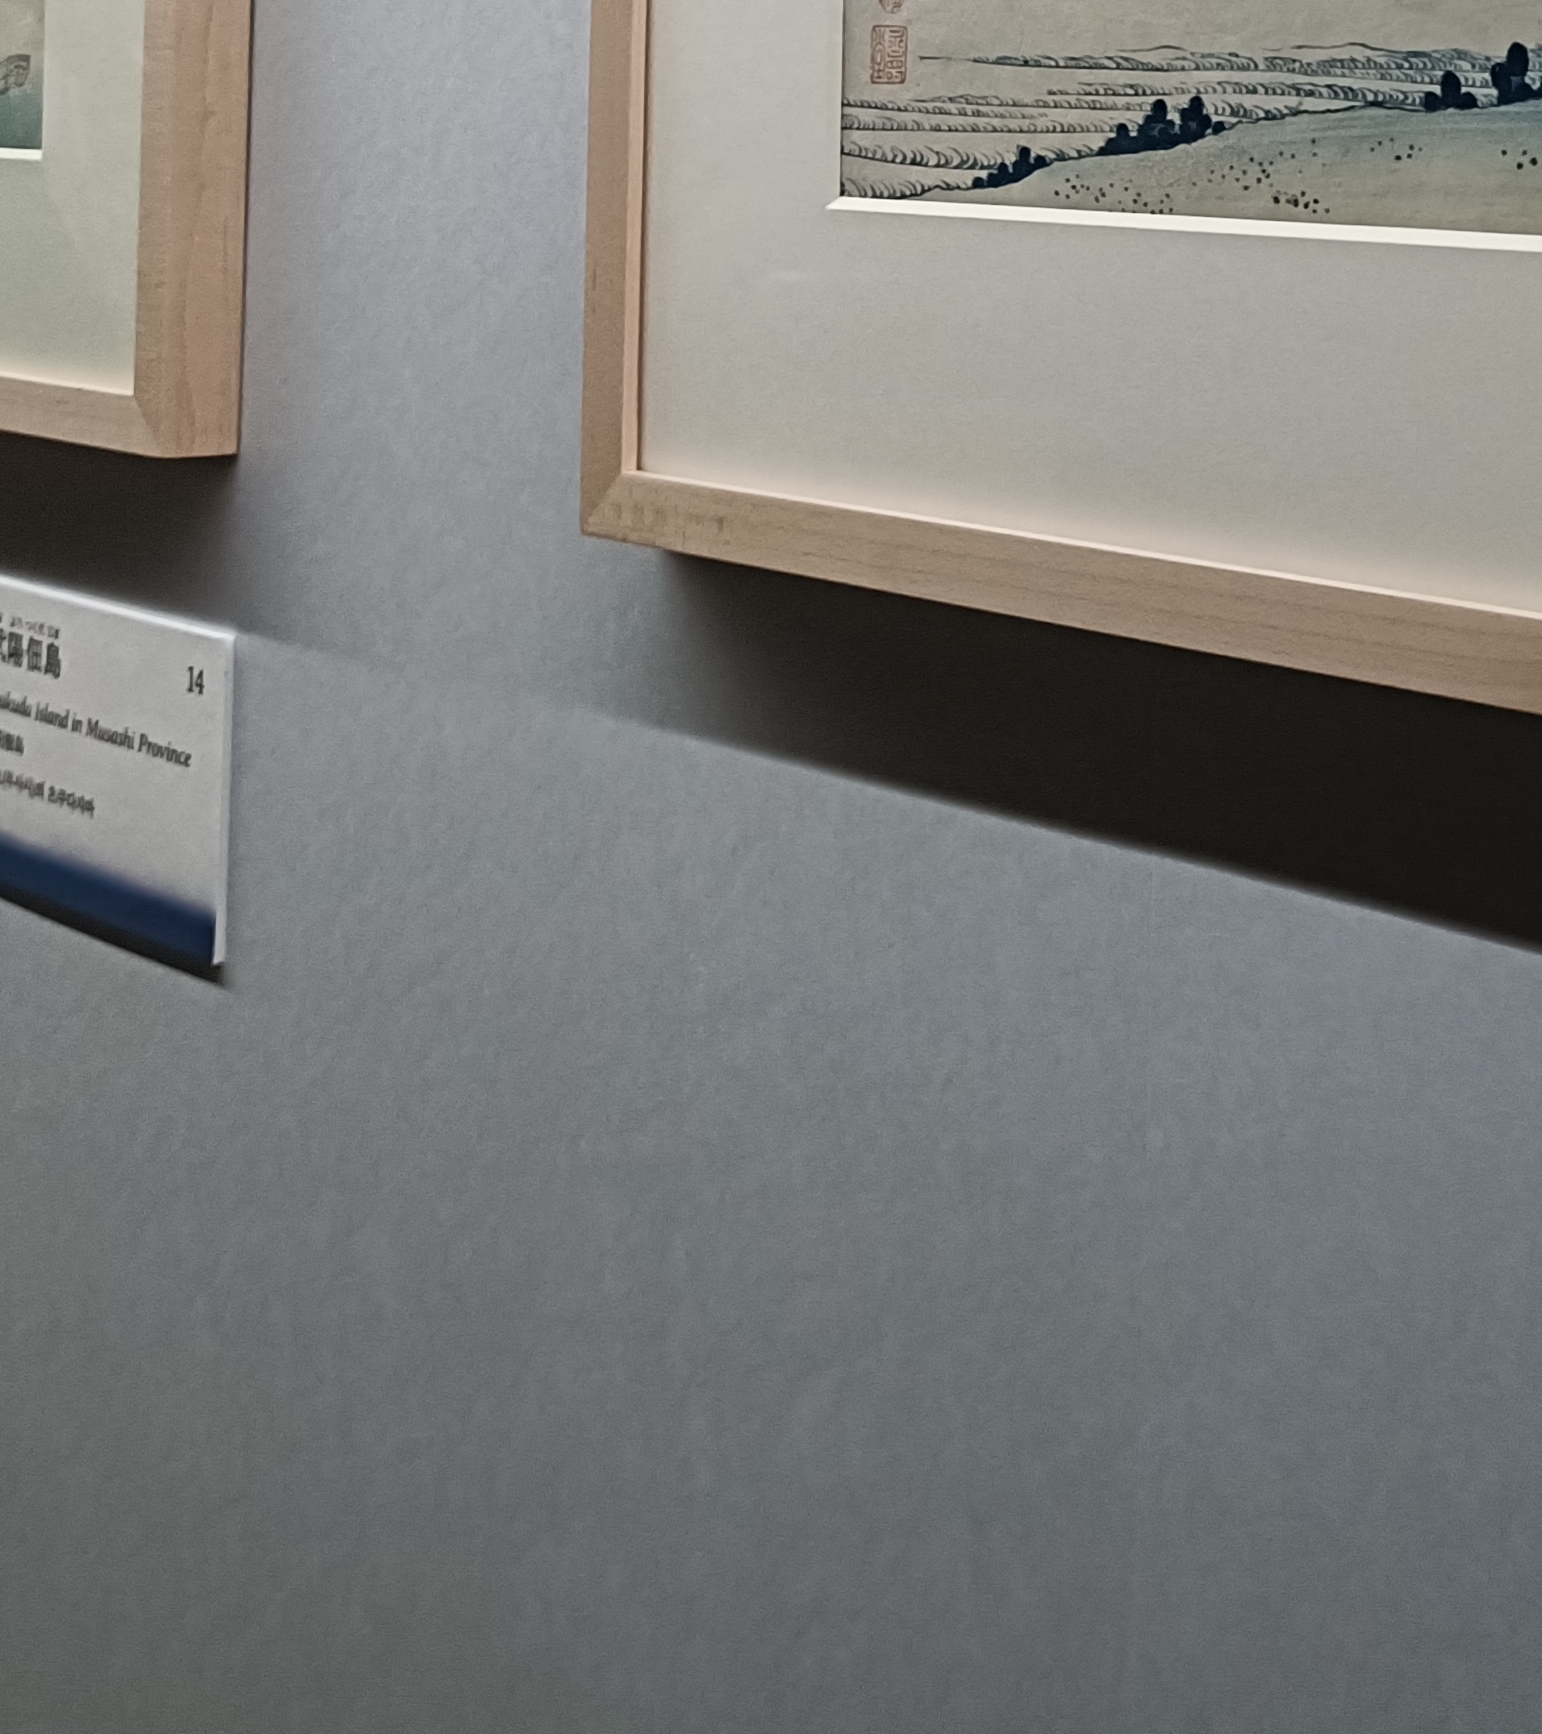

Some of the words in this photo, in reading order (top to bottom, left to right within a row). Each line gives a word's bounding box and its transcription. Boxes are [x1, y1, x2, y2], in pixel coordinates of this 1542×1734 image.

[186, 665, 206, 696] 14
[34, 701, 70, 730] Island
[72, 712, 84, 733] in
[137, 733, 193, 768] Province
